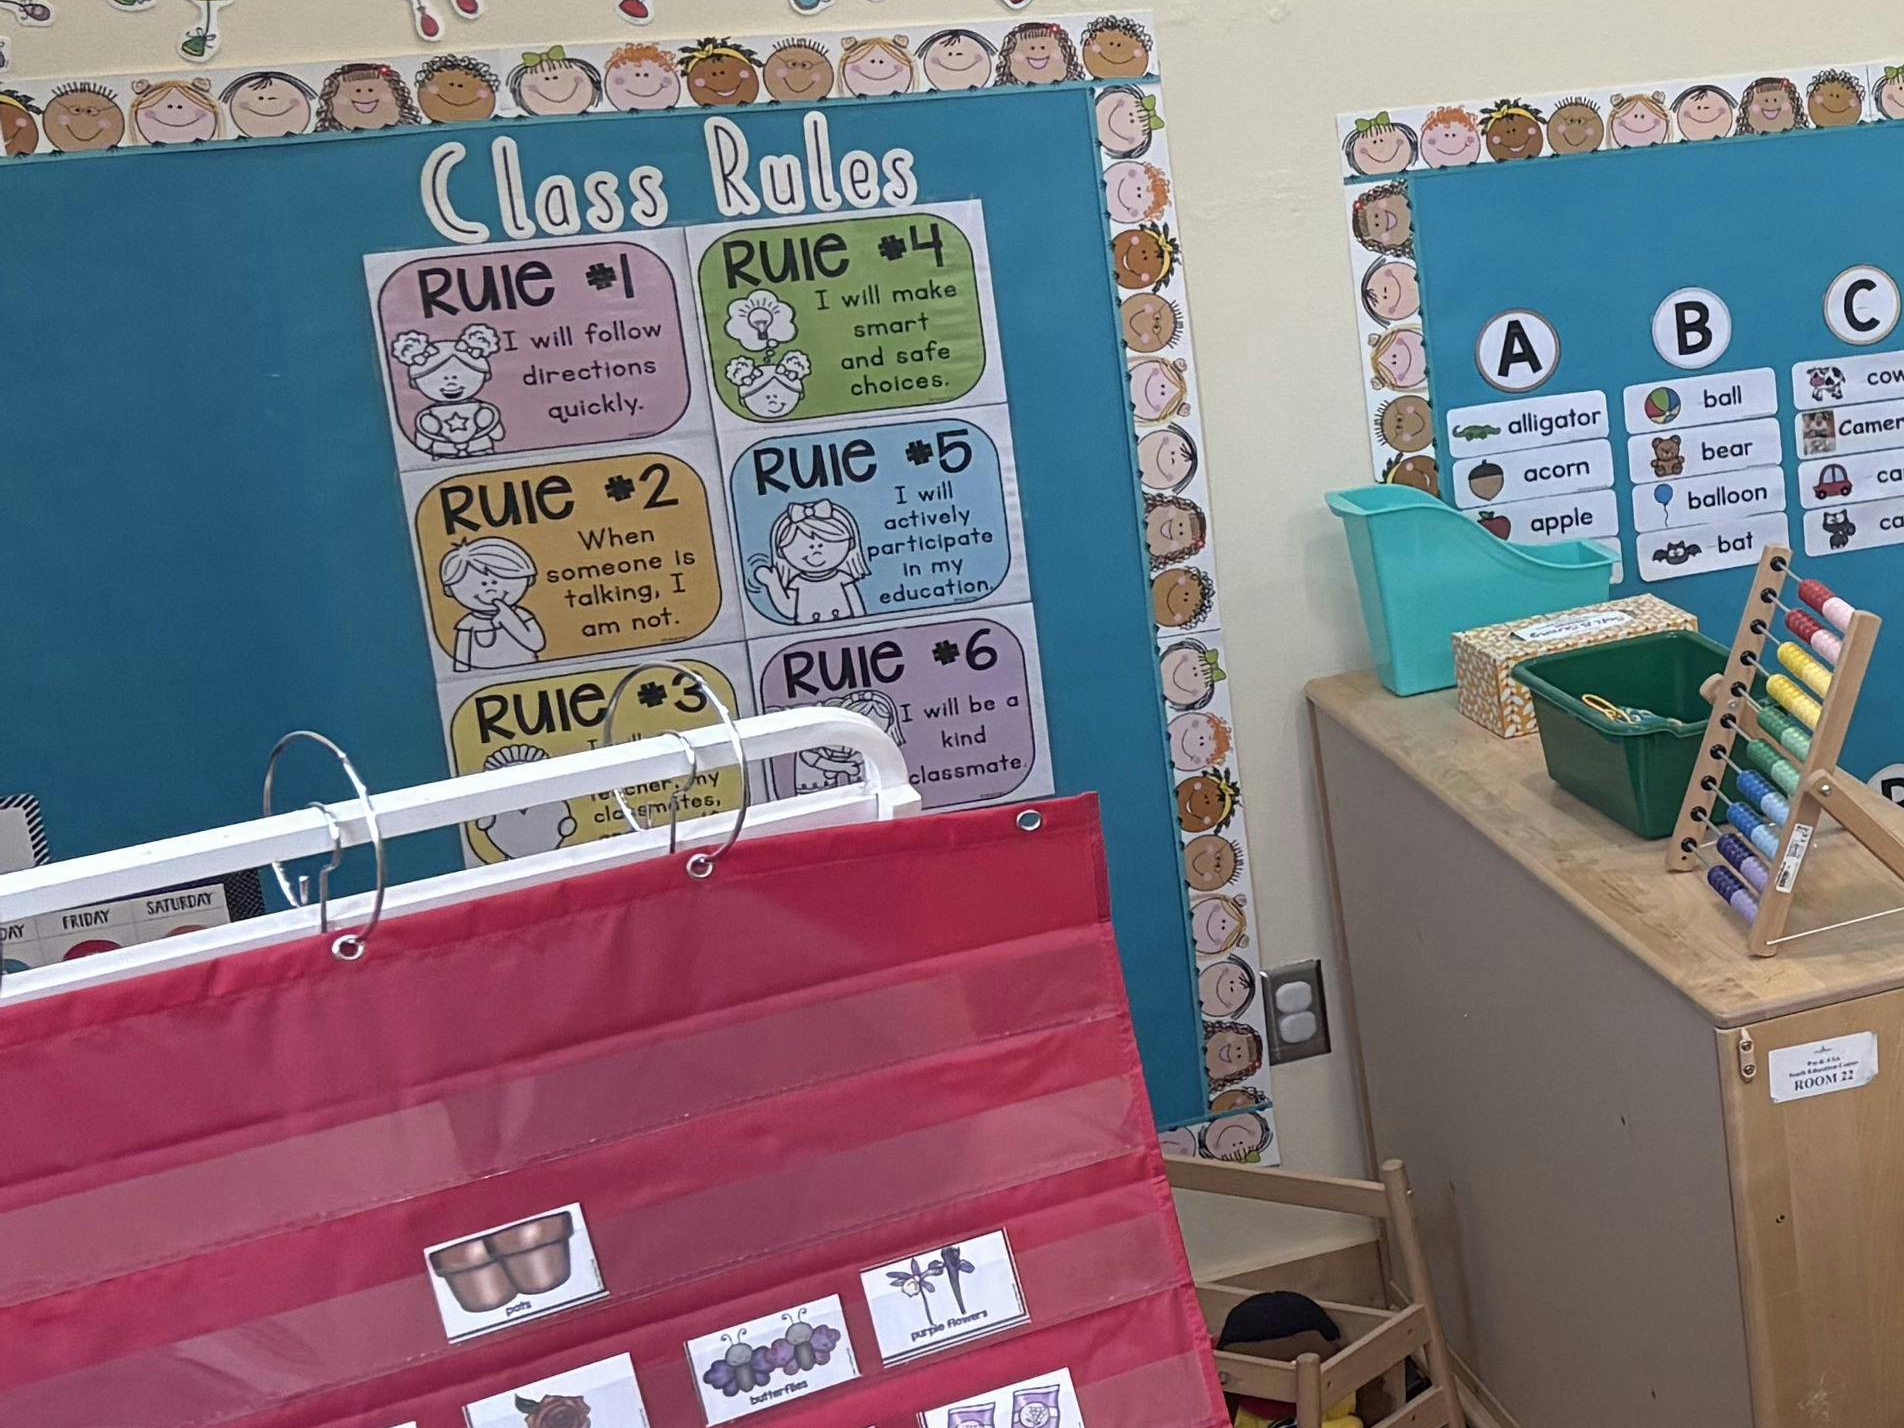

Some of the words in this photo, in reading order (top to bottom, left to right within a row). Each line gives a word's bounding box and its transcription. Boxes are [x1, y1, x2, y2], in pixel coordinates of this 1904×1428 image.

[421, 135, 667, 244] Class
[703, 110, 918, 217] Rules
[878, 223, 943, 267] #4
[586, 253, 634, 298] #1
[815, 289, 829, 310] I
[842, 284, 880, 307] will
[893, 279, 956, 303] make
[1844, 279, 1880, 332] C
[502, 331, 518, 351] I
[531, 326, 572, 348] will
[585, 320, 661, 344] follow
[854, 312, 928, 337] smart
[1675, 301, 1712, 355] B
[841, 346, 883, 369] and
[897, 340, 950, 364] safe
[1498, 320, 1542, 377] A
[523, 360, 656, 385] directions
[851, 375, 948, 396] choices.
[548, 392, 643, 423] quickly.
[1704, 385, 1741, 408] ball
[1509, 409, 1601, 436] alligator
[905, 429, 972, 473] #5
[1702, 442, 1752, 460] bear
[605, 463, 678, 509] #2
[1524, 462, 1589, 482] acorn
[895, 486, 907, 504] I
[918, 481, 953, 501] will
[1688, 486, 1767, 509] balloon
[884, 505, 969, 530] actively
[1531, 508, 1592, 536] apple
[578, 527, 654, 550] When
[867, 528, 992, 562] participate
[1718, 532, 1752, 553] bat
[547, 557, 661, 583] someone
[675, 550, 695, 565] is
[904, 563, 921, 576] in
[932, 559, 962, 575] my
[565, 584, 659, 608] talking,
[671, 573, 685, 593] I
[880, 578, 994, 604] education.
[582, 622, 620, 637] am
[632, 607, 679, 630] not.
[933, 640, 999, 671] #6
[900, 704, 912, 722] I
[924, 697, 959, 718] will
[969, 695, 994, 713] be
[1007, 696, 1018, 707] a
[942, 725, 986, 747] kind
[907, 753, 1027, 785] classmate.
[63, 910, 109, 929] FRIDAY
[147, 893, 212, 914] SATURDAY
[1794, 1074, 1837, 1090] ROOM
[1841, 1070, 1854, 1081] 22
[911, 1323, 944, 1342] purple
[947, 1310, 987, 1328] flowers
[750, 1381, 808, 1405] butterflies
